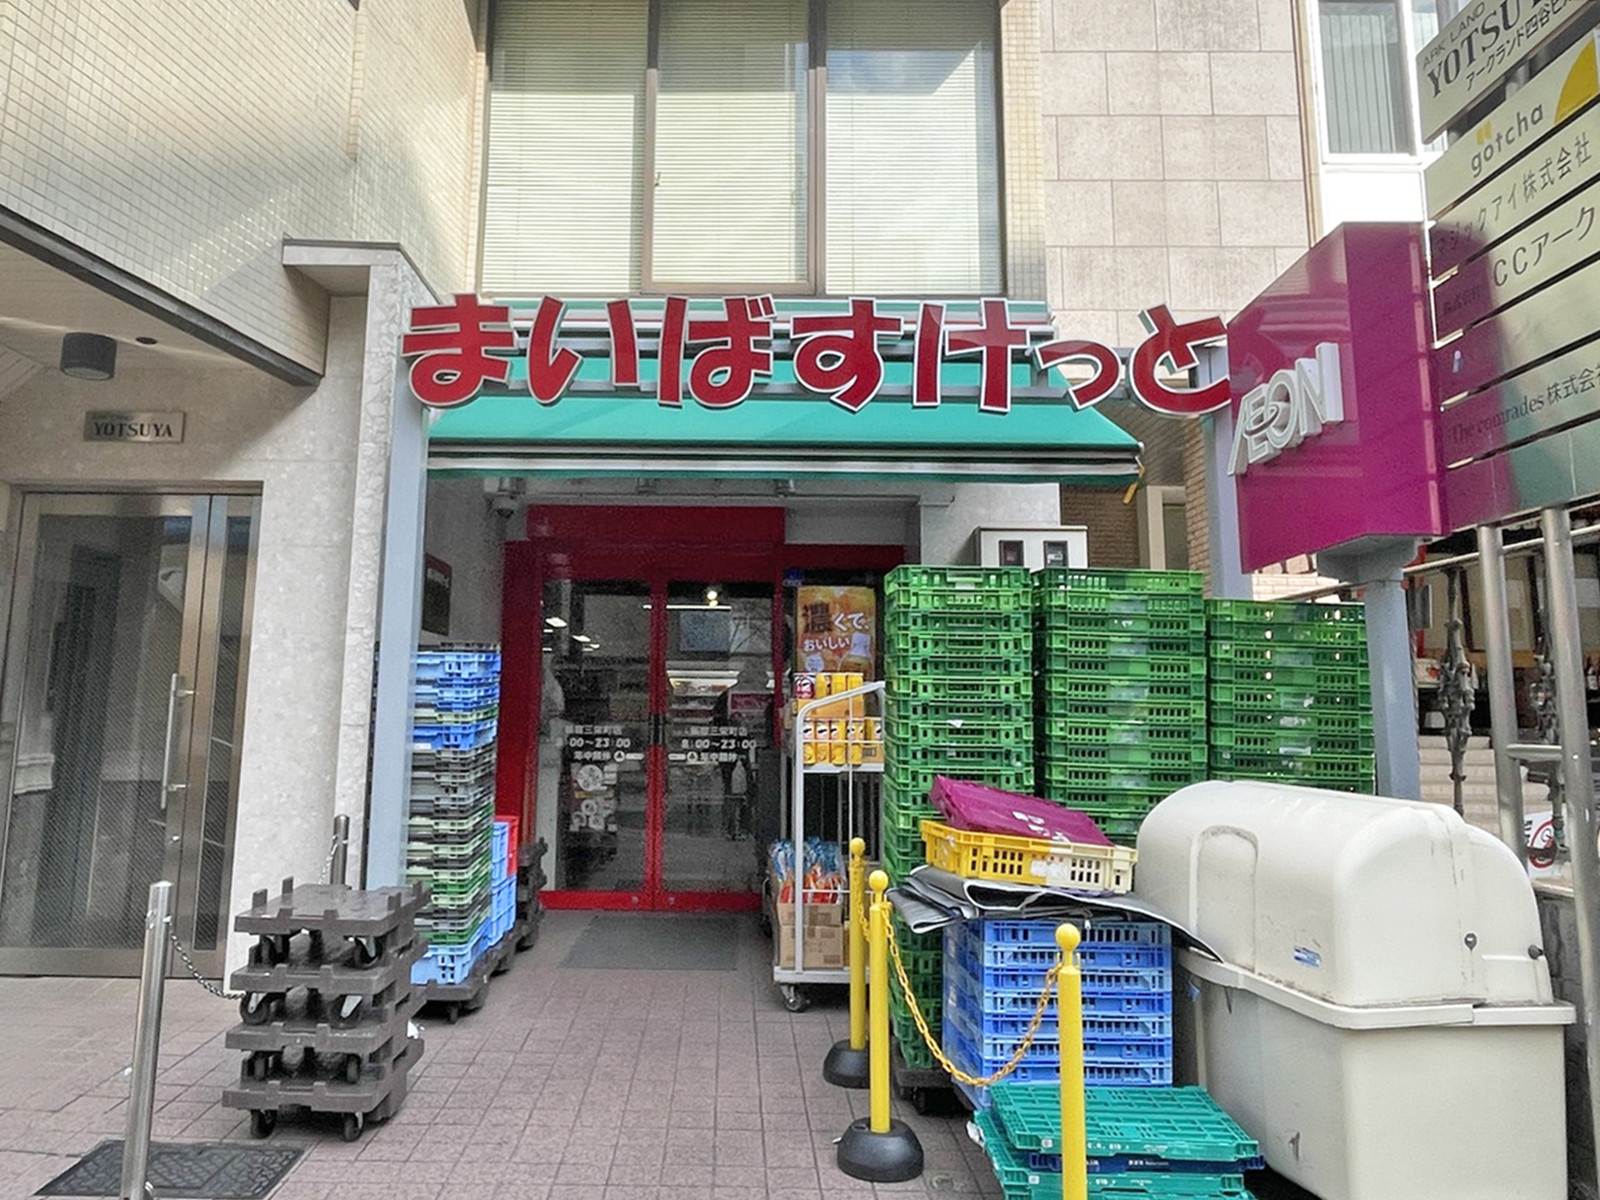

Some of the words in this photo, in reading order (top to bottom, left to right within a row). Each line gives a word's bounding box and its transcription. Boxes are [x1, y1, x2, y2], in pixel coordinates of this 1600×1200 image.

[1423, 38, 1447, 70] ARK
[1450, 2, 1486, 43] LAND
[1426, 0, 1544, 99] YOTSU
[1470, 103, 1545, 179] gotcha
[1493, 206, 1596, 287] CCアーク
[402, 293, 1230, 415] まいばすけっと
[94, 422, 173, 437] YOTSUYA
[803, 636, 850, 652] おいしい
